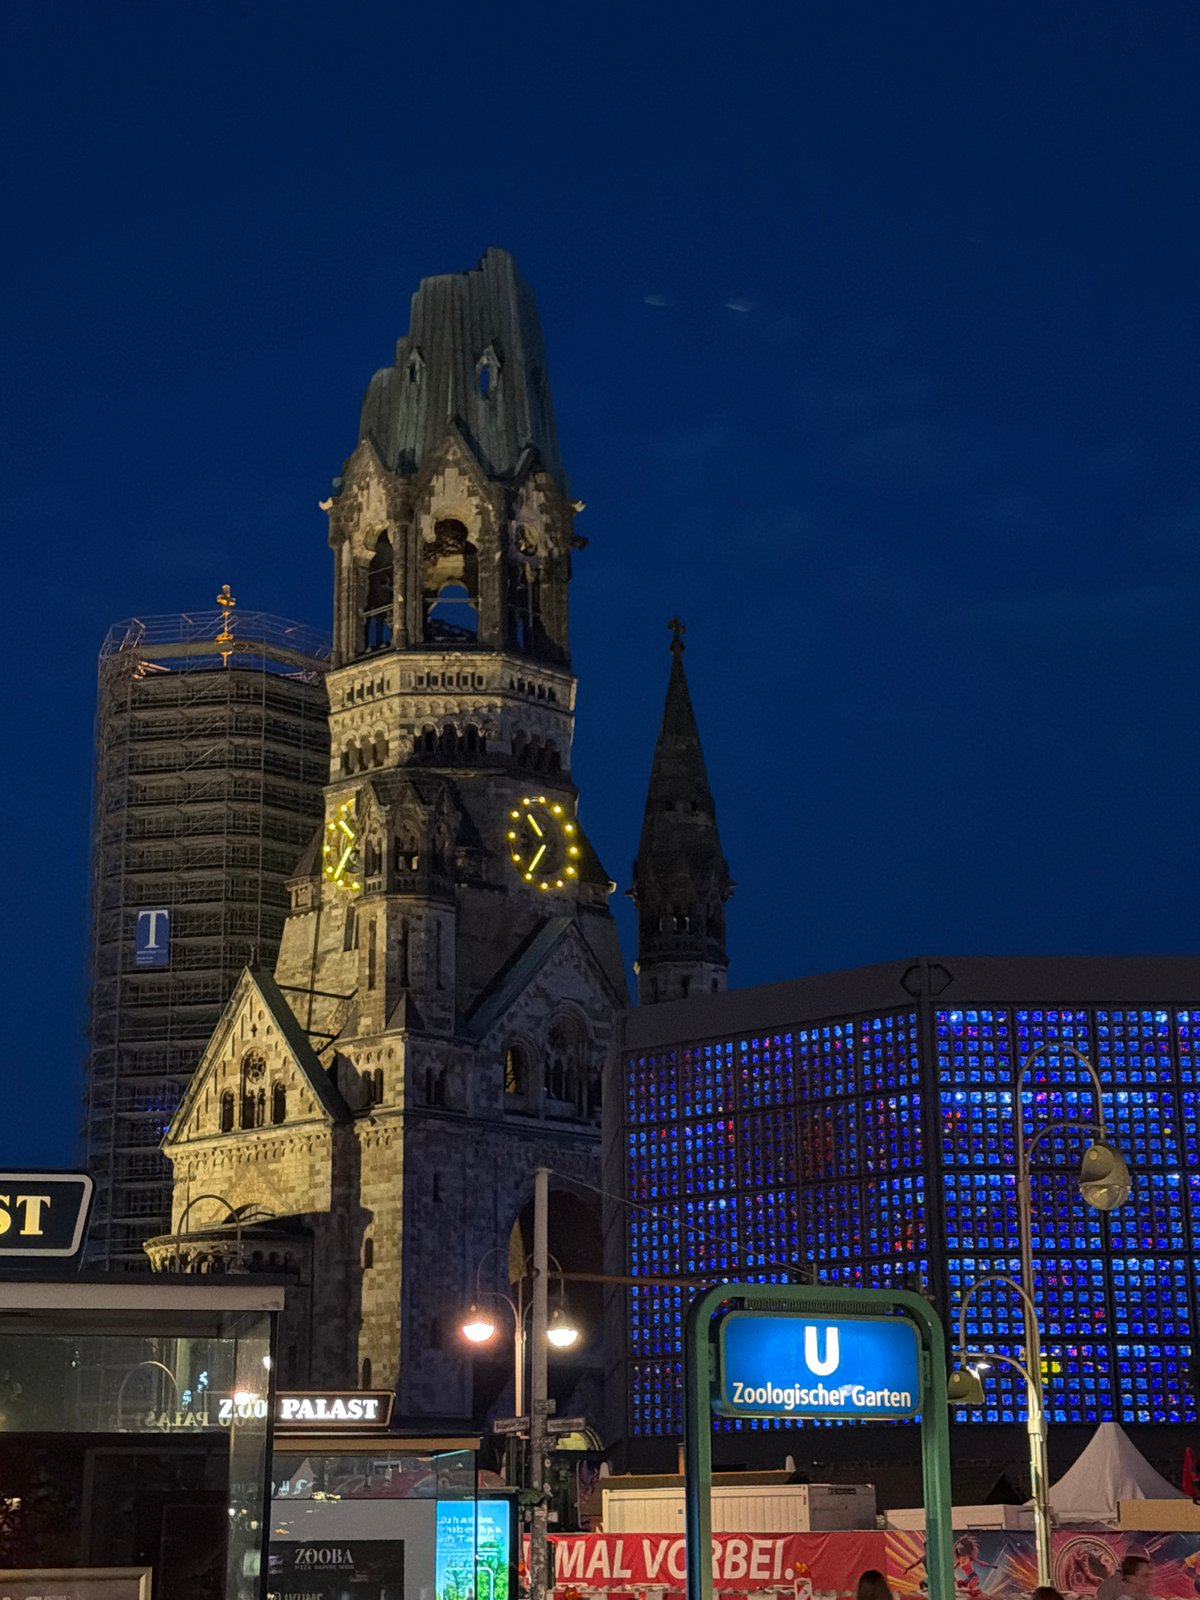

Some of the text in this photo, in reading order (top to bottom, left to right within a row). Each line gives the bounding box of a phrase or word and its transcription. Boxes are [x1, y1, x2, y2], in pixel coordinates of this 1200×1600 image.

[138, 910, 168, 948] T
[804, 1326, 840, 1377] U
[280, 1398, 379, 1420] PALAST
[732, 1381, 912, 1411] Zoologischer Garten
[293, 1548, 354, 1565] ZOOBA
[555, 1539, 632, 1579] MAL
